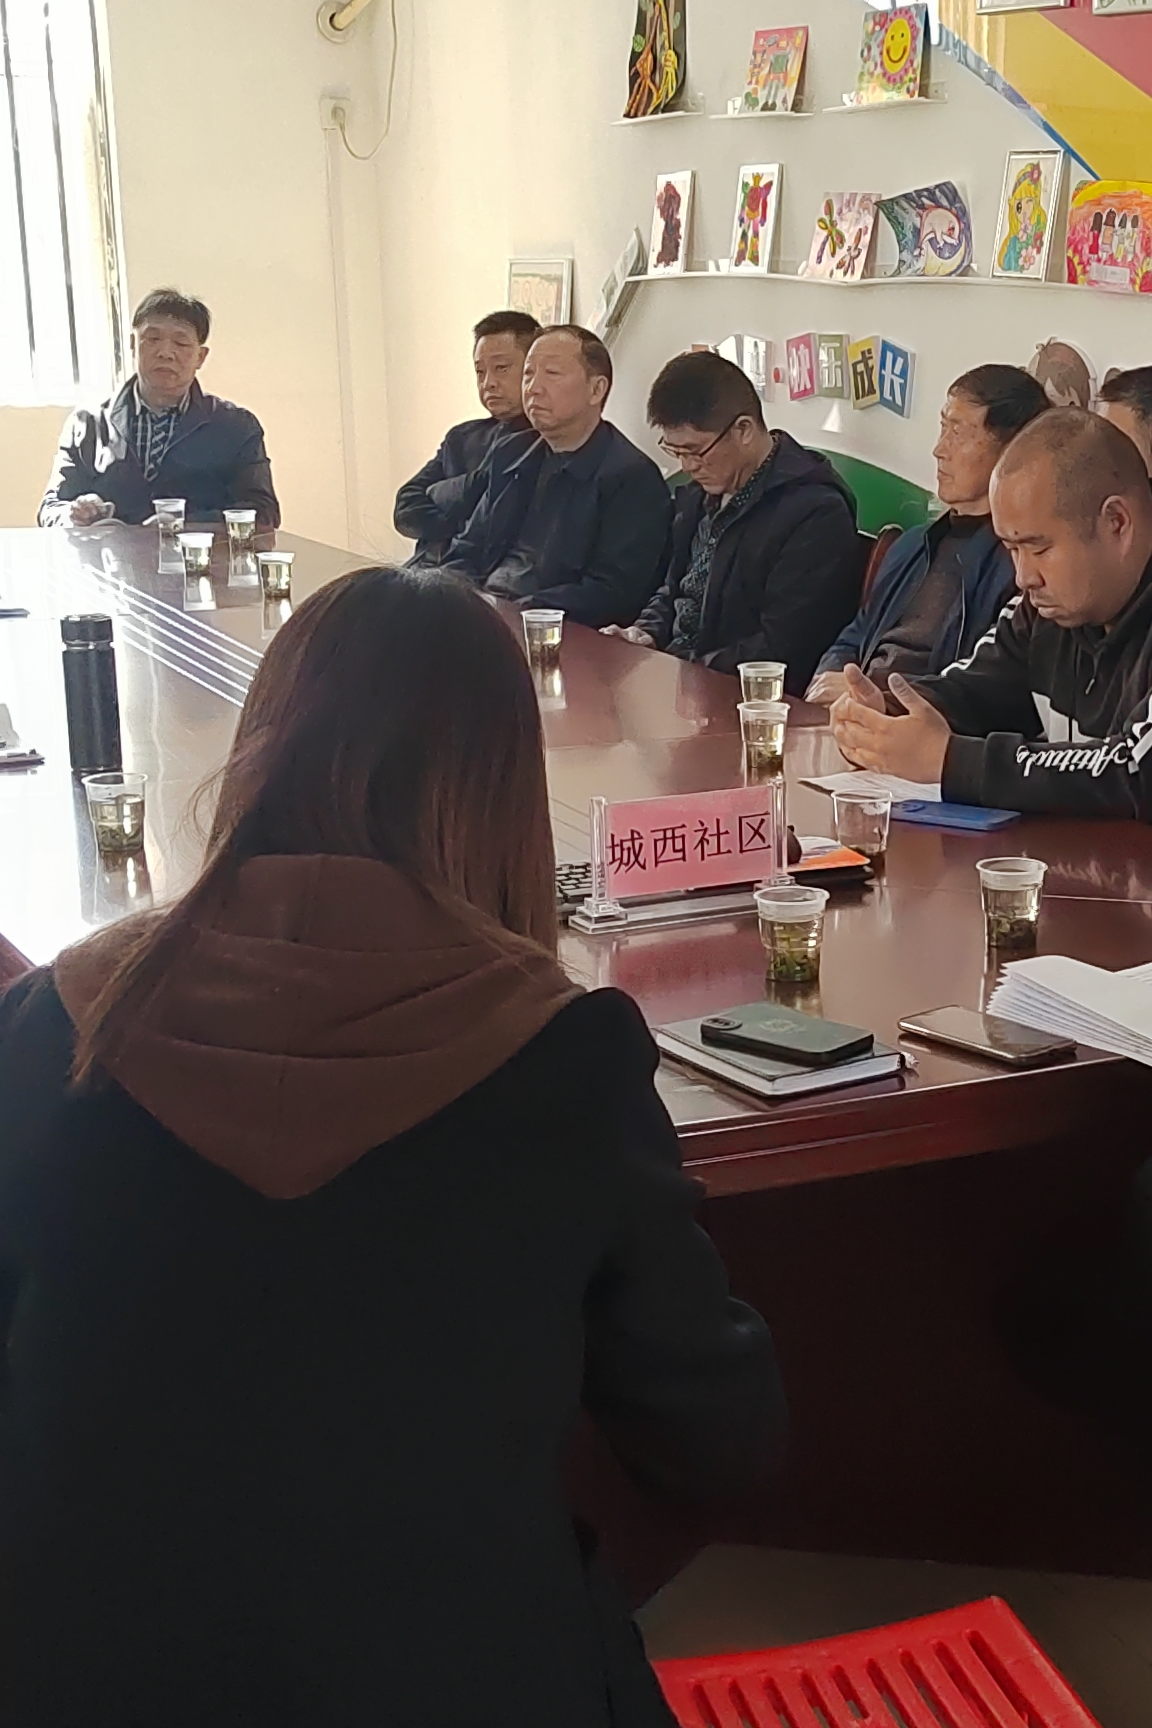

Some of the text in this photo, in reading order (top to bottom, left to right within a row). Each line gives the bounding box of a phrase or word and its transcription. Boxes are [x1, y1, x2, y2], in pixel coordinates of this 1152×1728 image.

[789, 343, 904, 407] 快乐成长
[607, 811, 772, 875] 城西社区
